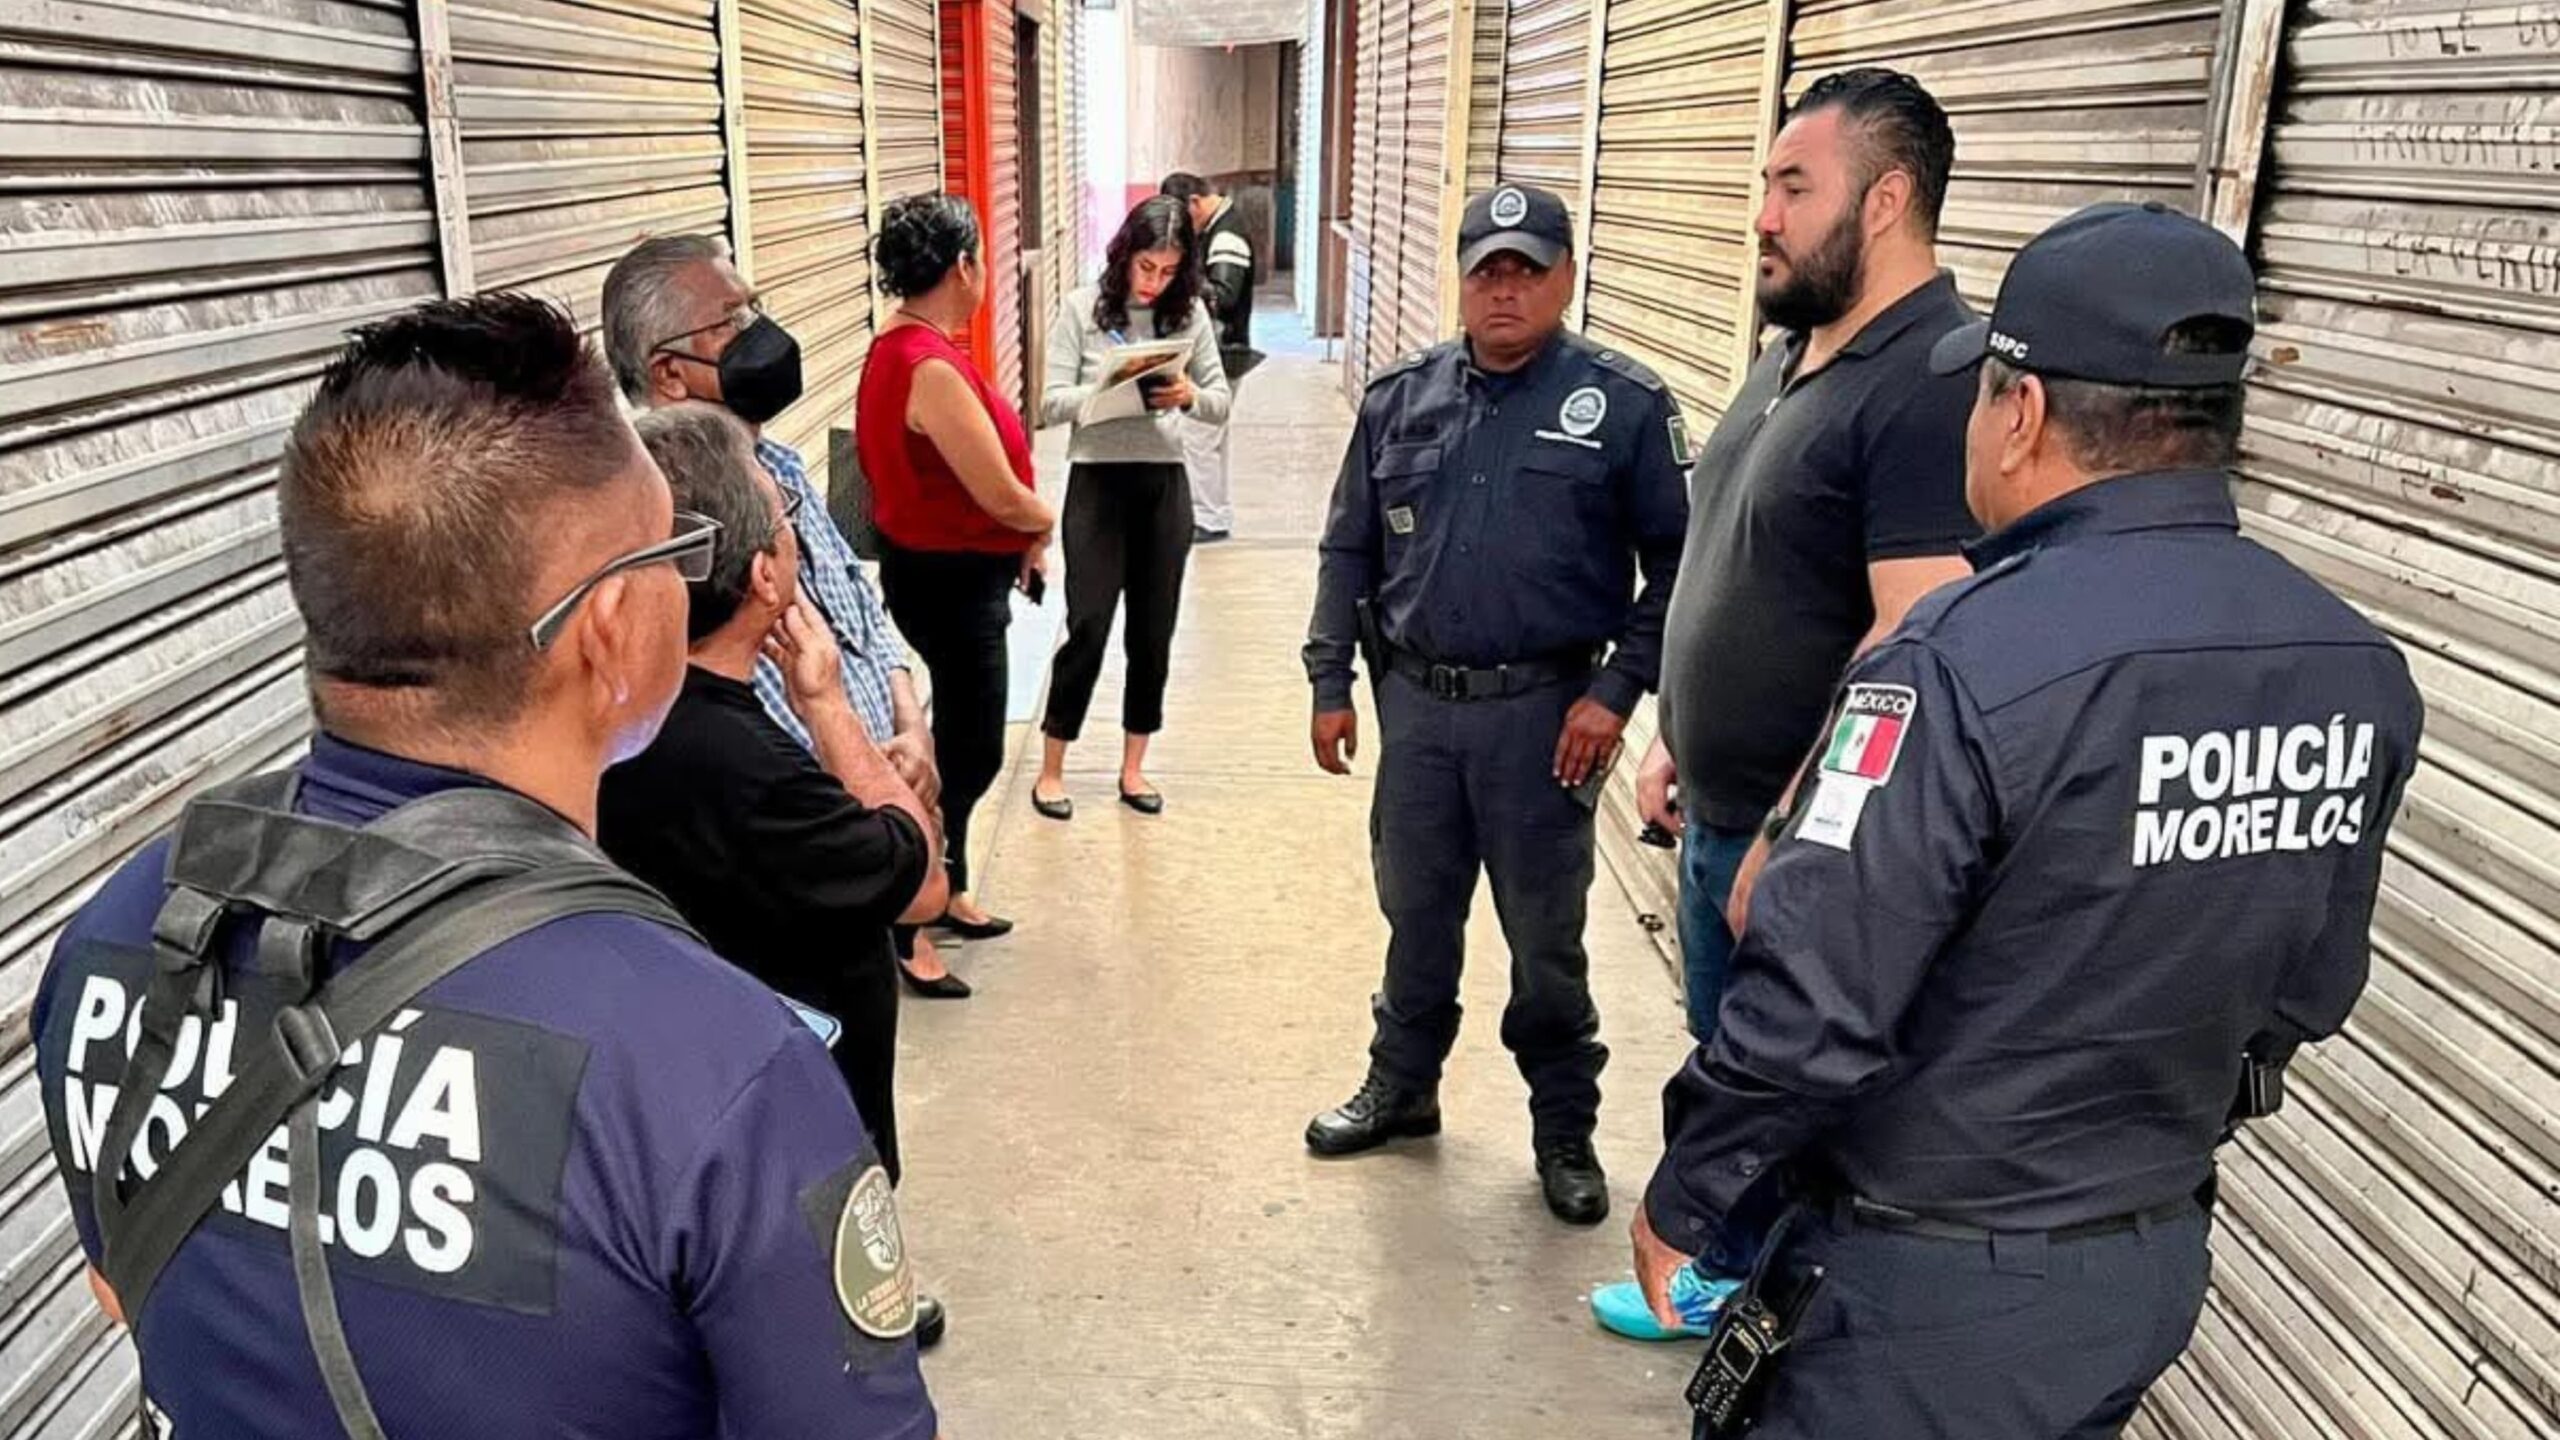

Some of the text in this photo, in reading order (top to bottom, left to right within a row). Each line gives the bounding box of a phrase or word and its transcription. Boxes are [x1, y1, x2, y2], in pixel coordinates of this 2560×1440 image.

[1989, 331, 2029, 359] SSPC
[2138, 713, 2375, 804] POLICÍA
[2133, 794, 2366, 867] MORELOS
